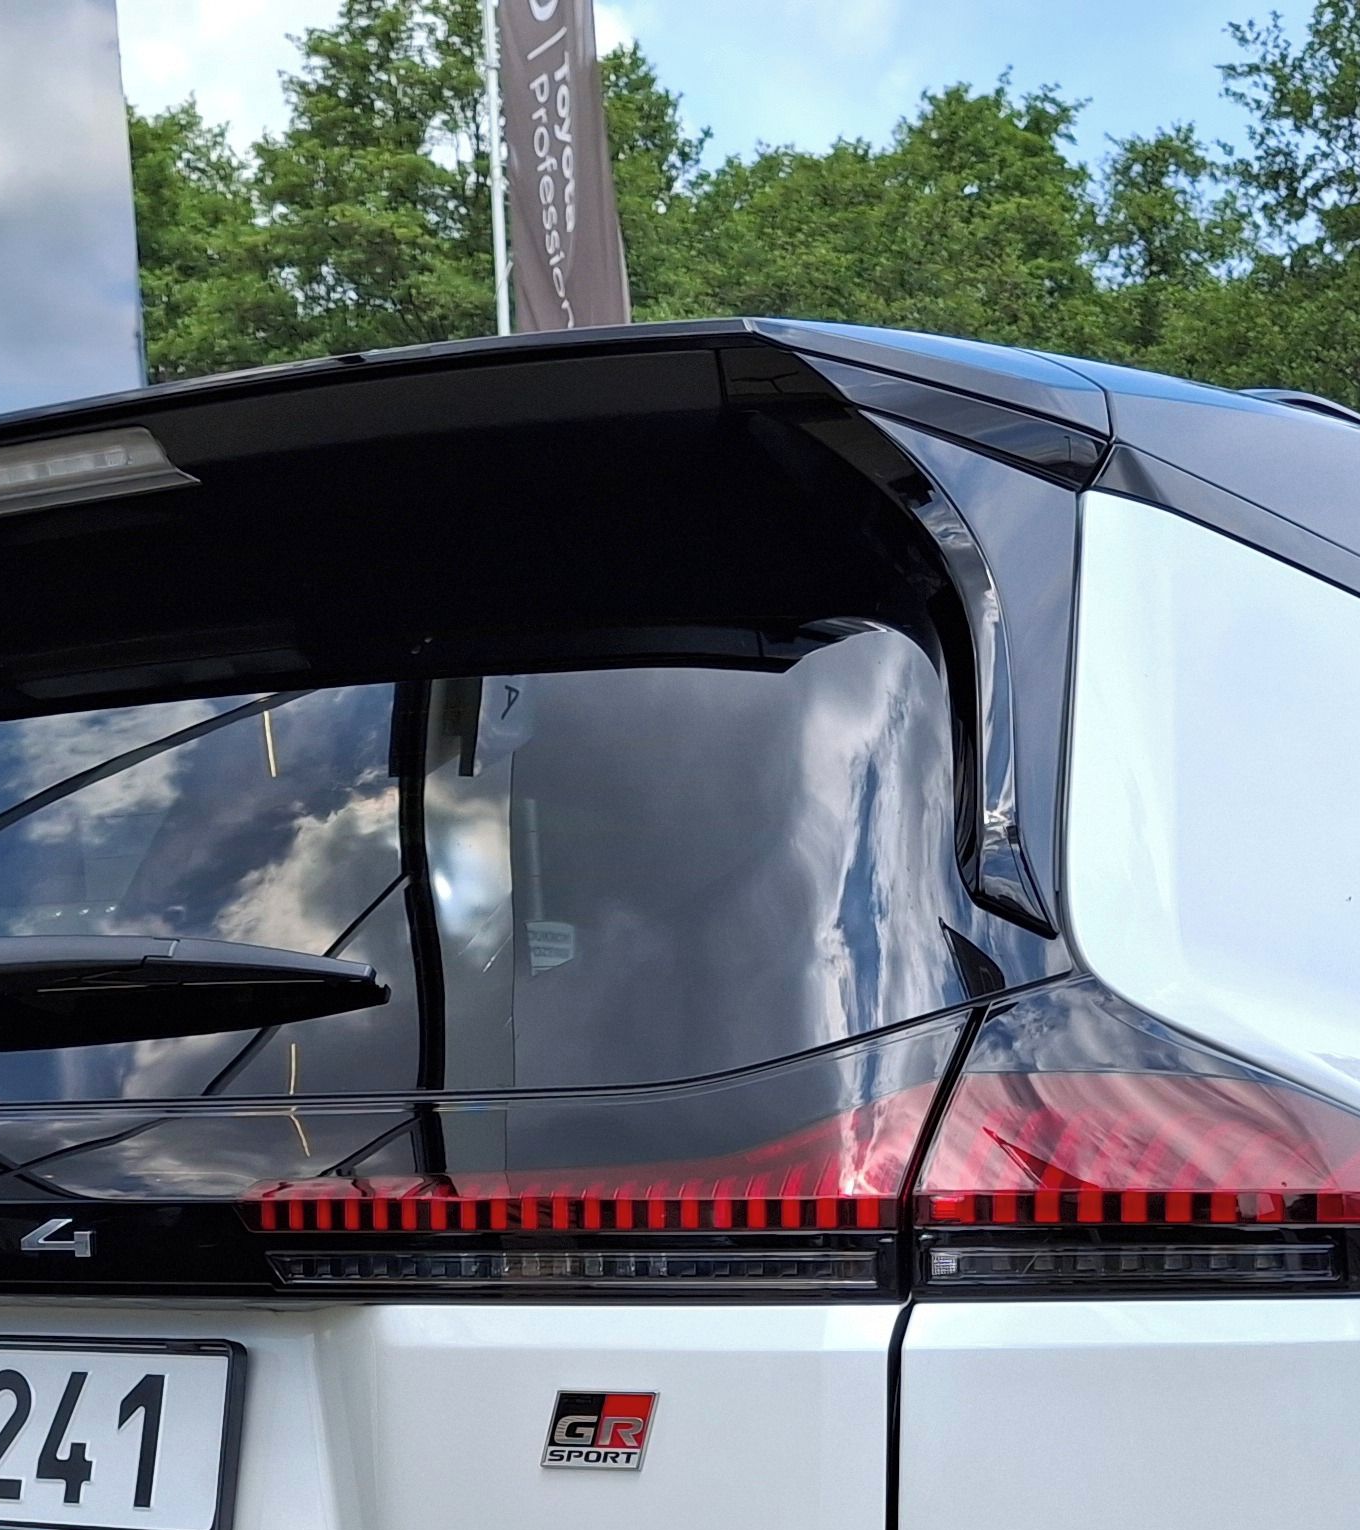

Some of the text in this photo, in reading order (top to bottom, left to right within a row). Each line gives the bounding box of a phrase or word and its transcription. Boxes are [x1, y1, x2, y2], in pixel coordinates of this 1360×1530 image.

[554, 50, 576, 233] Toyota
[553, 1414, 644, 1447] GR
[547, 1449, 638, 1465] SPORT
